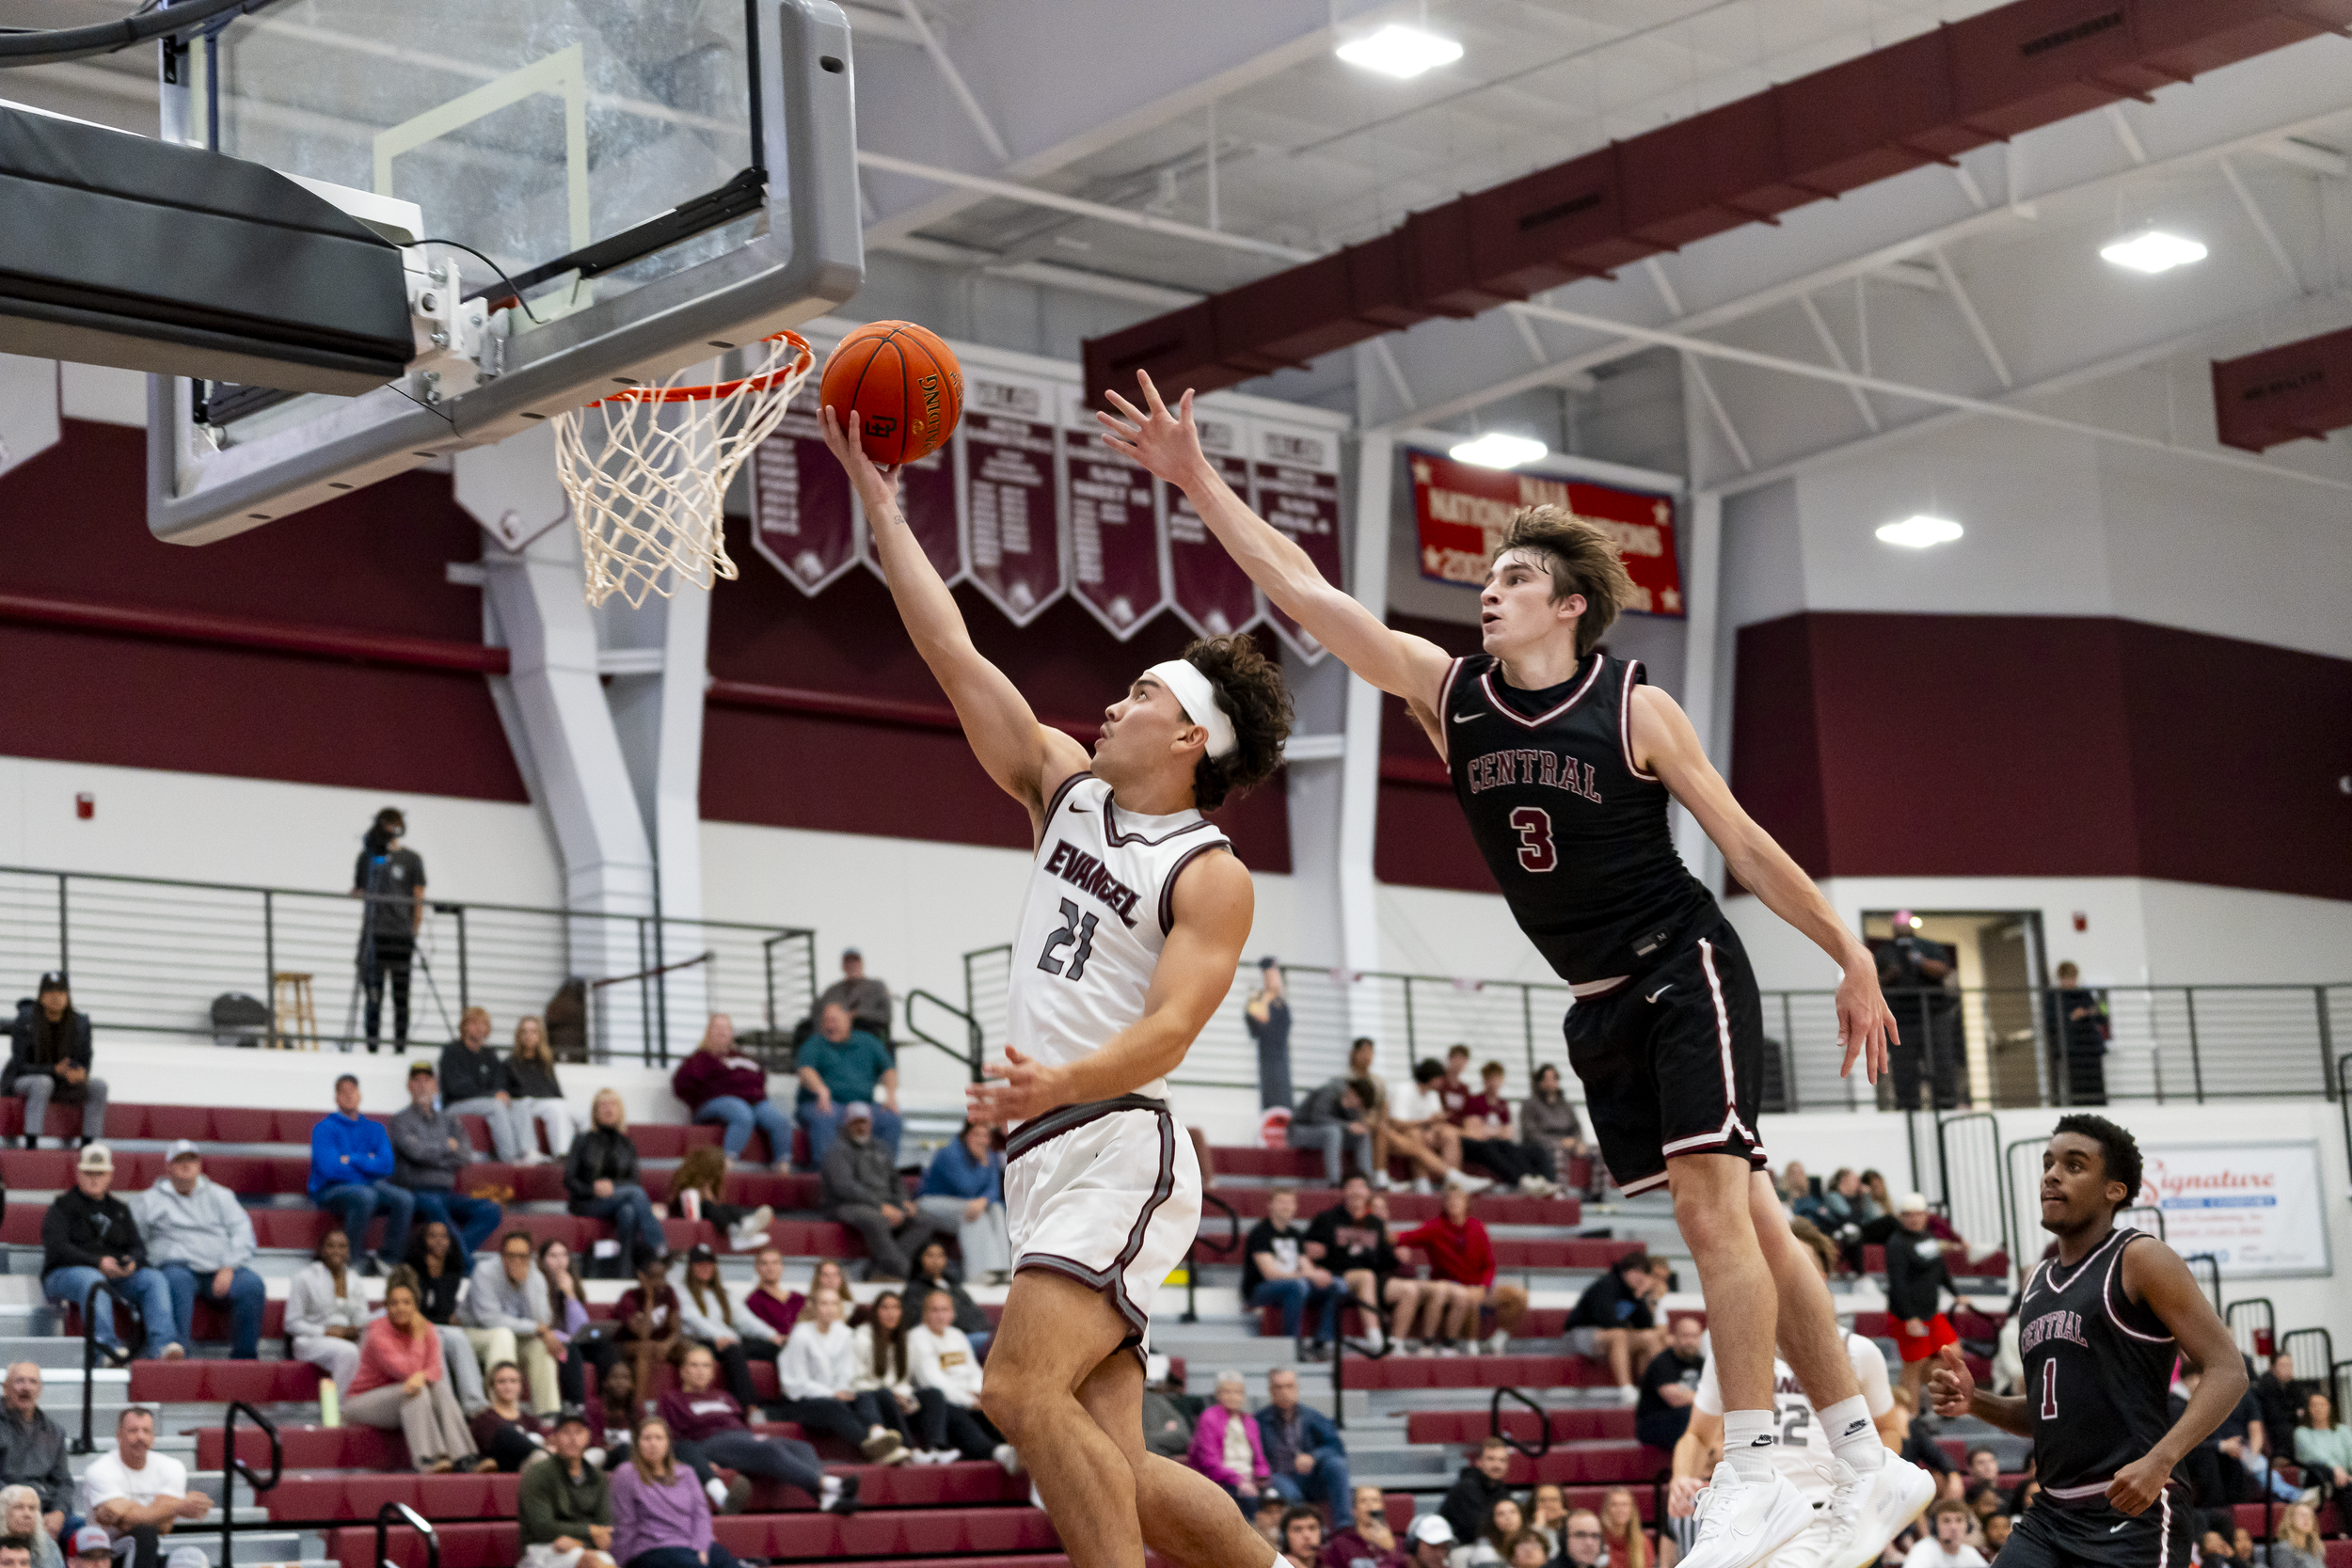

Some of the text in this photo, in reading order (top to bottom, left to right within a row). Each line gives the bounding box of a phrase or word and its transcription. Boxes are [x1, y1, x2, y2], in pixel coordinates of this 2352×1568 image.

[917, 373, 941, 459] PALDING
[1467, 749, 1602, 804] CENTRAL
[1509, 806, 1558, 873] 3
[1043, 838, 1142, 929] EVANGEL
[1037, 896, 1099, 982] 21
[2042, 1357, 2058, 1420] 1
